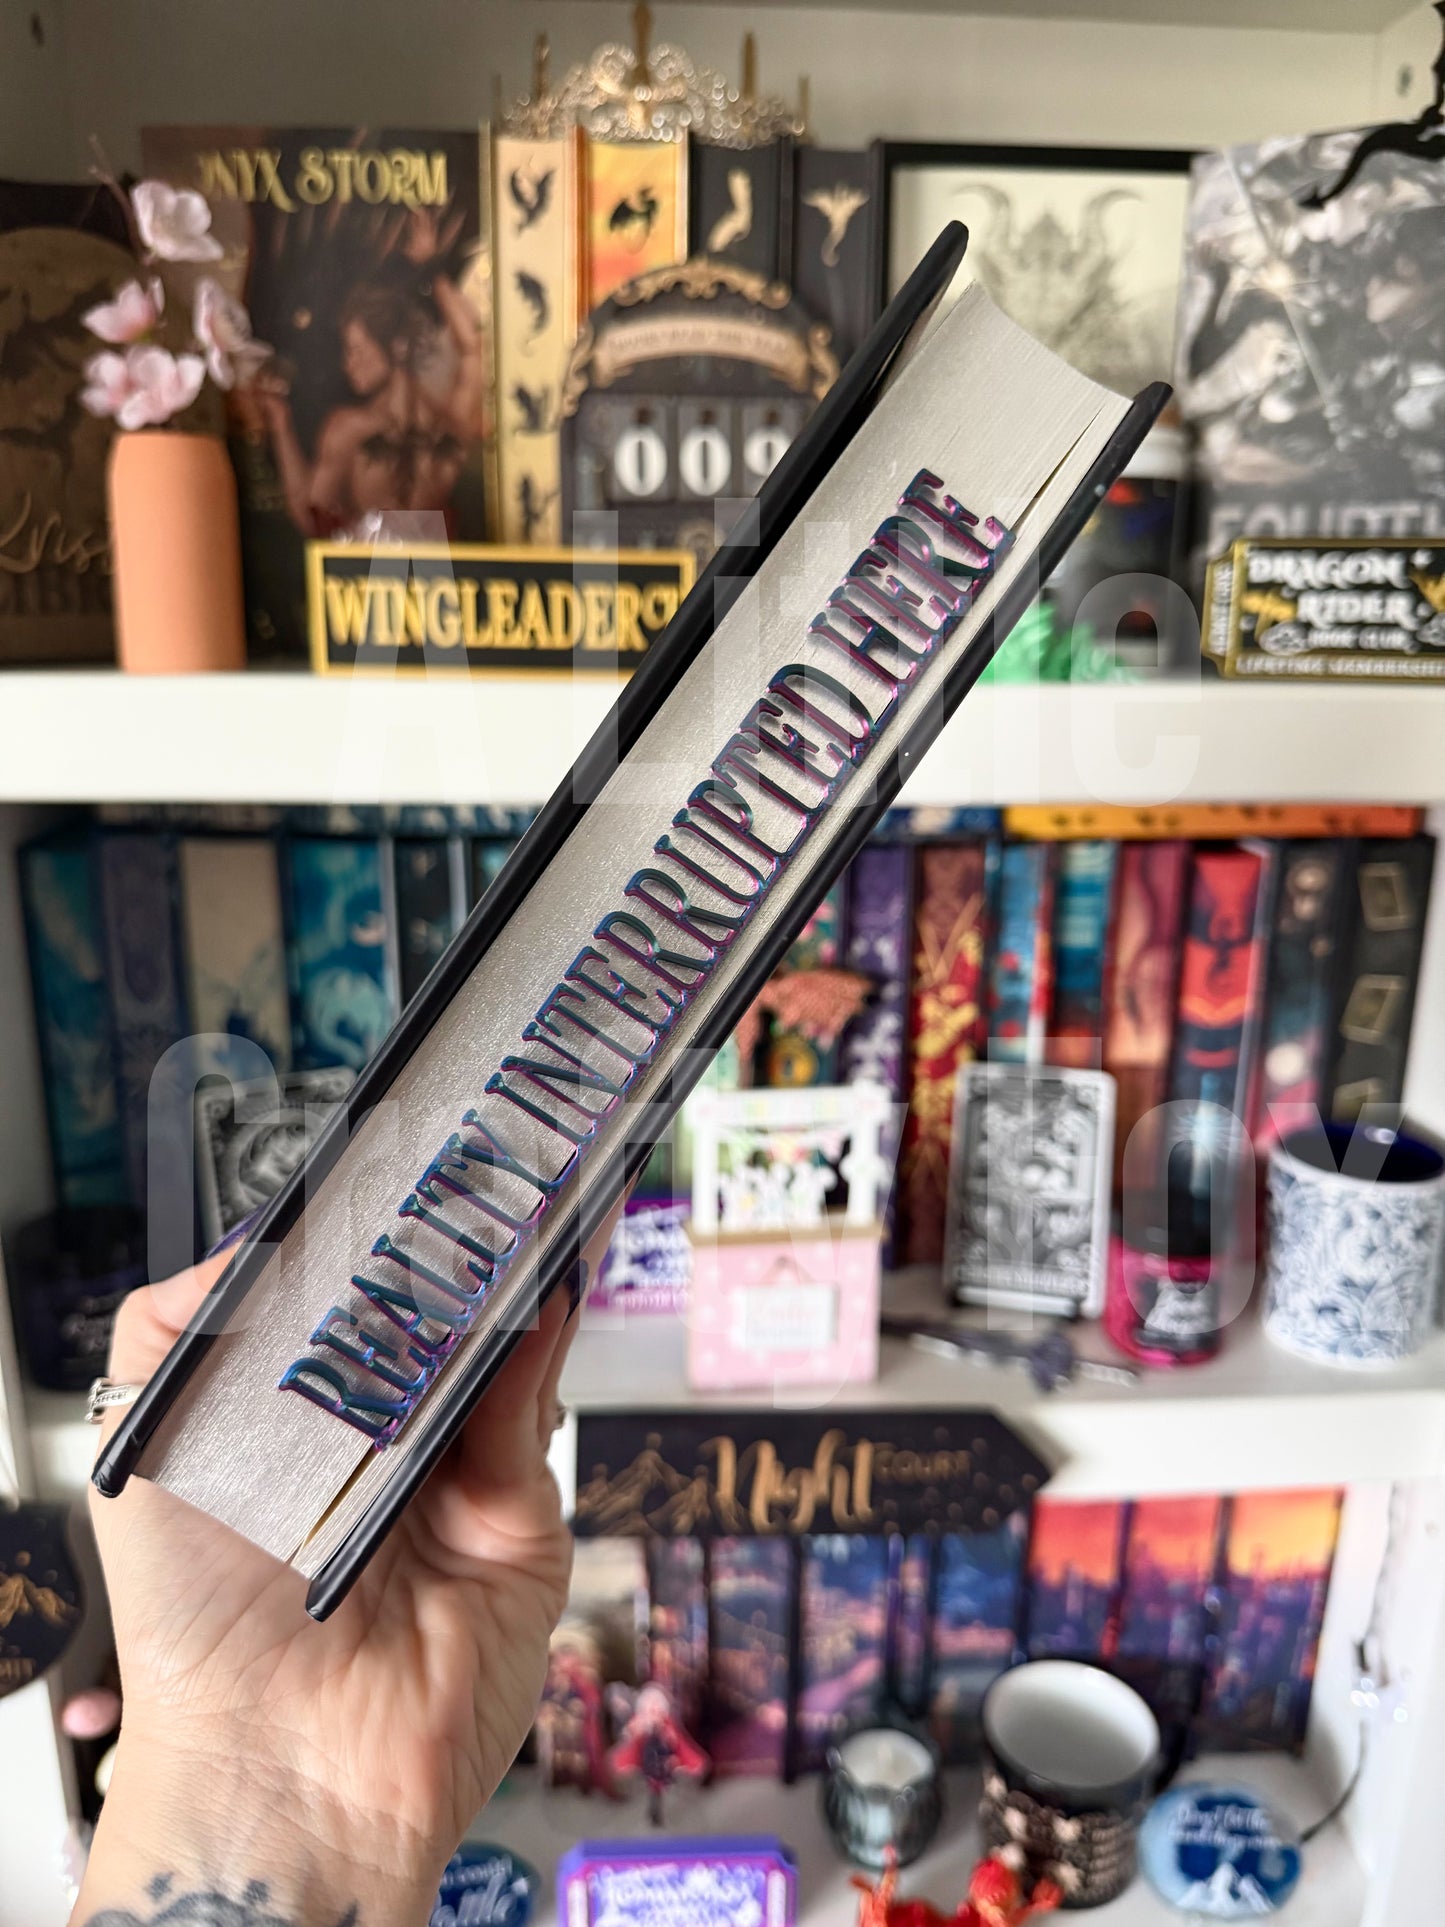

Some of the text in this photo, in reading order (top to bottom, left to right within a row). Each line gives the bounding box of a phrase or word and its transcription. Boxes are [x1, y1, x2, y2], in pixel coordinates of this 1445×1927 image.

[297, 146, 448, 213] STORM
[1248, 549, 1411, 590] DRAGON
[325, 576, 649, 652] WINGLEADER
[1297, 590, 1420, 630] RIDER
[278, 1108, 570, 1450] REALITY
[484, 663, 880, 1145] INTERRUPTED
[808, 468, 1017, 700] HERE
